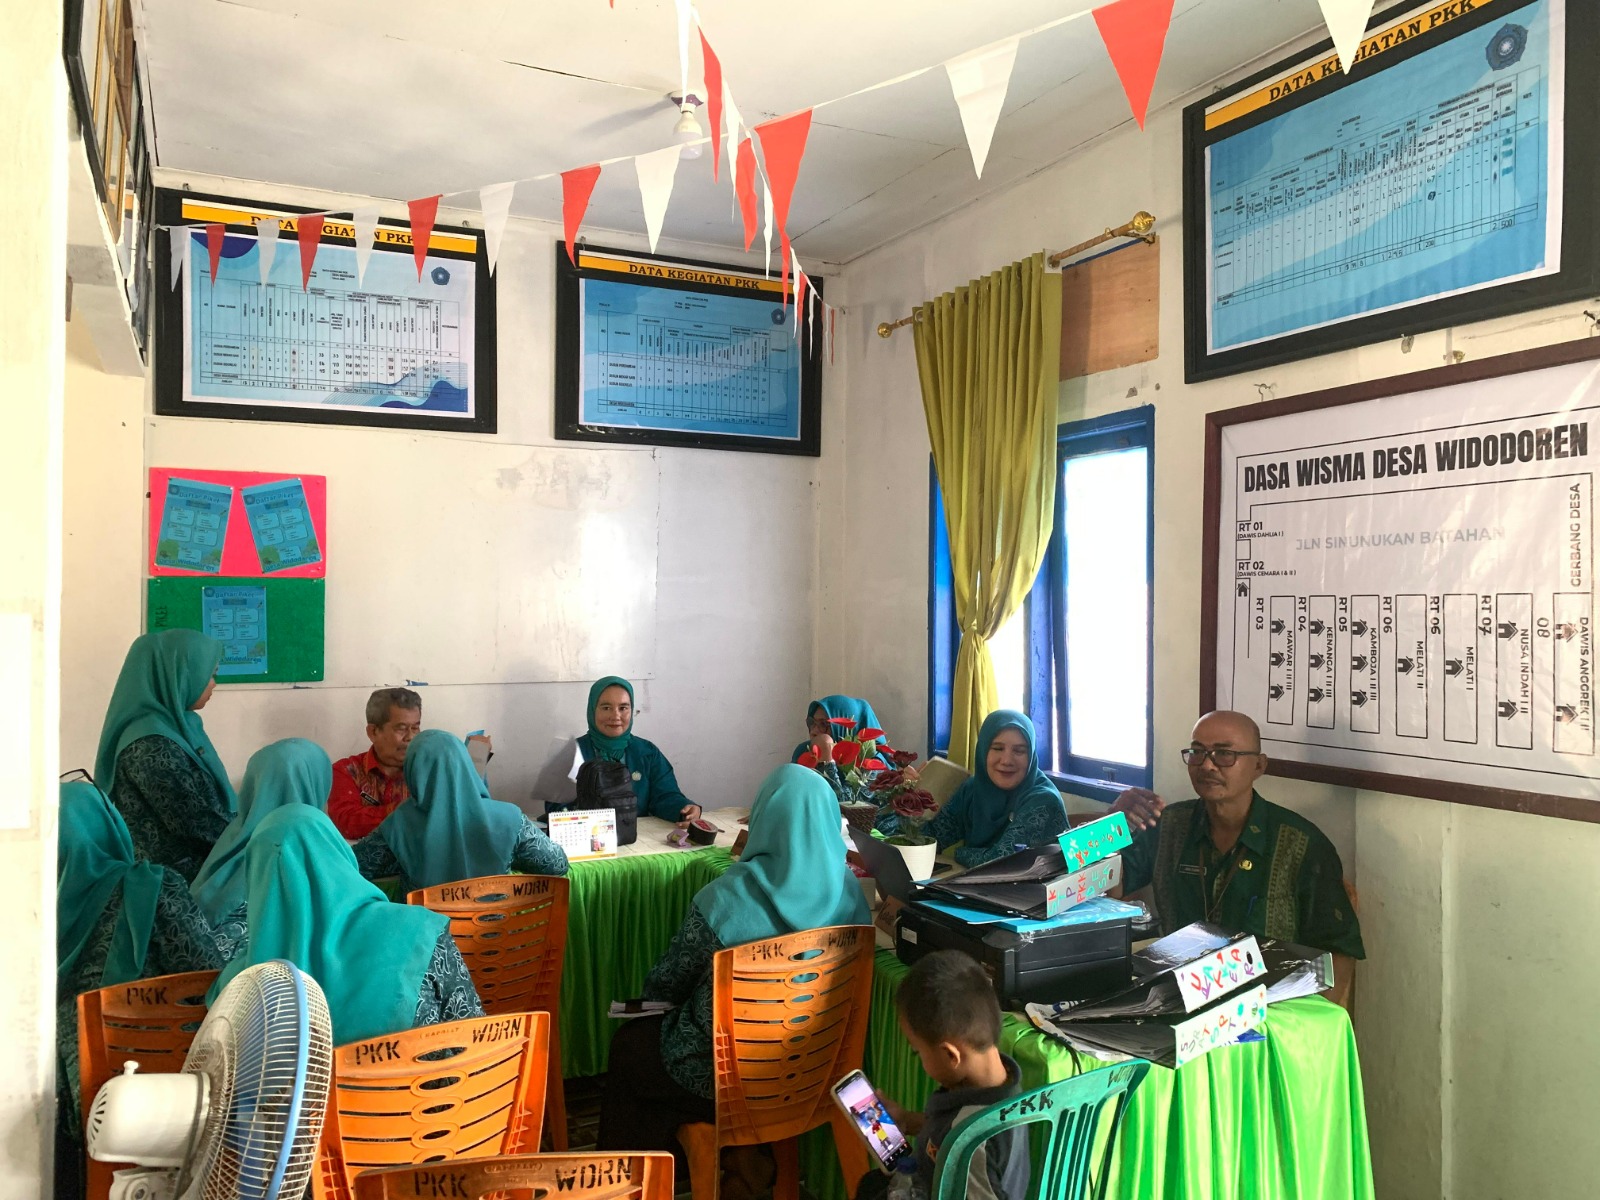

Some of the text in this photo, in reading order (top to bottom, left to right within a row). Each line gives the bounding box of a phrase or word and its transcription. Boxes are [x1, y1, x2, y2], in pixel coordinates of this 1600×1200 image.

[1269, 71, 1315, 102] DATA
[1429, 0, 1475, 28] PKK
[1427, 164, 1436, 172] 66
[250, 216, 295, 230] DTA
[629, 264, 760, 290] DATA KEGIATAN PKK
[1244, 422, 1588, 493] DASA WISMA DESA WIDODOREN
[1238, 521, 1263, 532] RT 01
[1295, 526, 1505, 551] JLN SINUNUKAN BATAHAN
[1569, 483, 1581, 587] GERBANG DESA
[1238, 561, 1265, 571] RT 02
[1255, 597, 1264, 630] RT 03
[1298, 596, 1307, 632] RT 04
[1338, 597, 1348, 632] RT 05
[1382, 596, 1393, 634] RT 06
[1429, 596, 1441, 635] RT 06
[1481, 595, 1492, 613] RT
[1326, 626, 1334, 673] KENANGA
[1520, 628, 1529, 659] NUSA
[1579, 616, 1589, 656] DAWIS
[1416, 640, 1424, 678] MELATI
[1466, 646, 1474, 685] MELATI
[1520, 662, 1529, 698] INDAH
[1580, 658, 1590, 715] ANGGREK
[441, 885, 472, 902] PKK
[512, 879, 550, 897] WDRN
[752, 942, 785, 962] PKK
[126, 986, 169, 1006] PKK
[354, 1017, 523, 1066] PKK WDRN
[999, 1089, 1054, 1122] PKK
[413, 1157, 633, 1199] PKK WDRN
